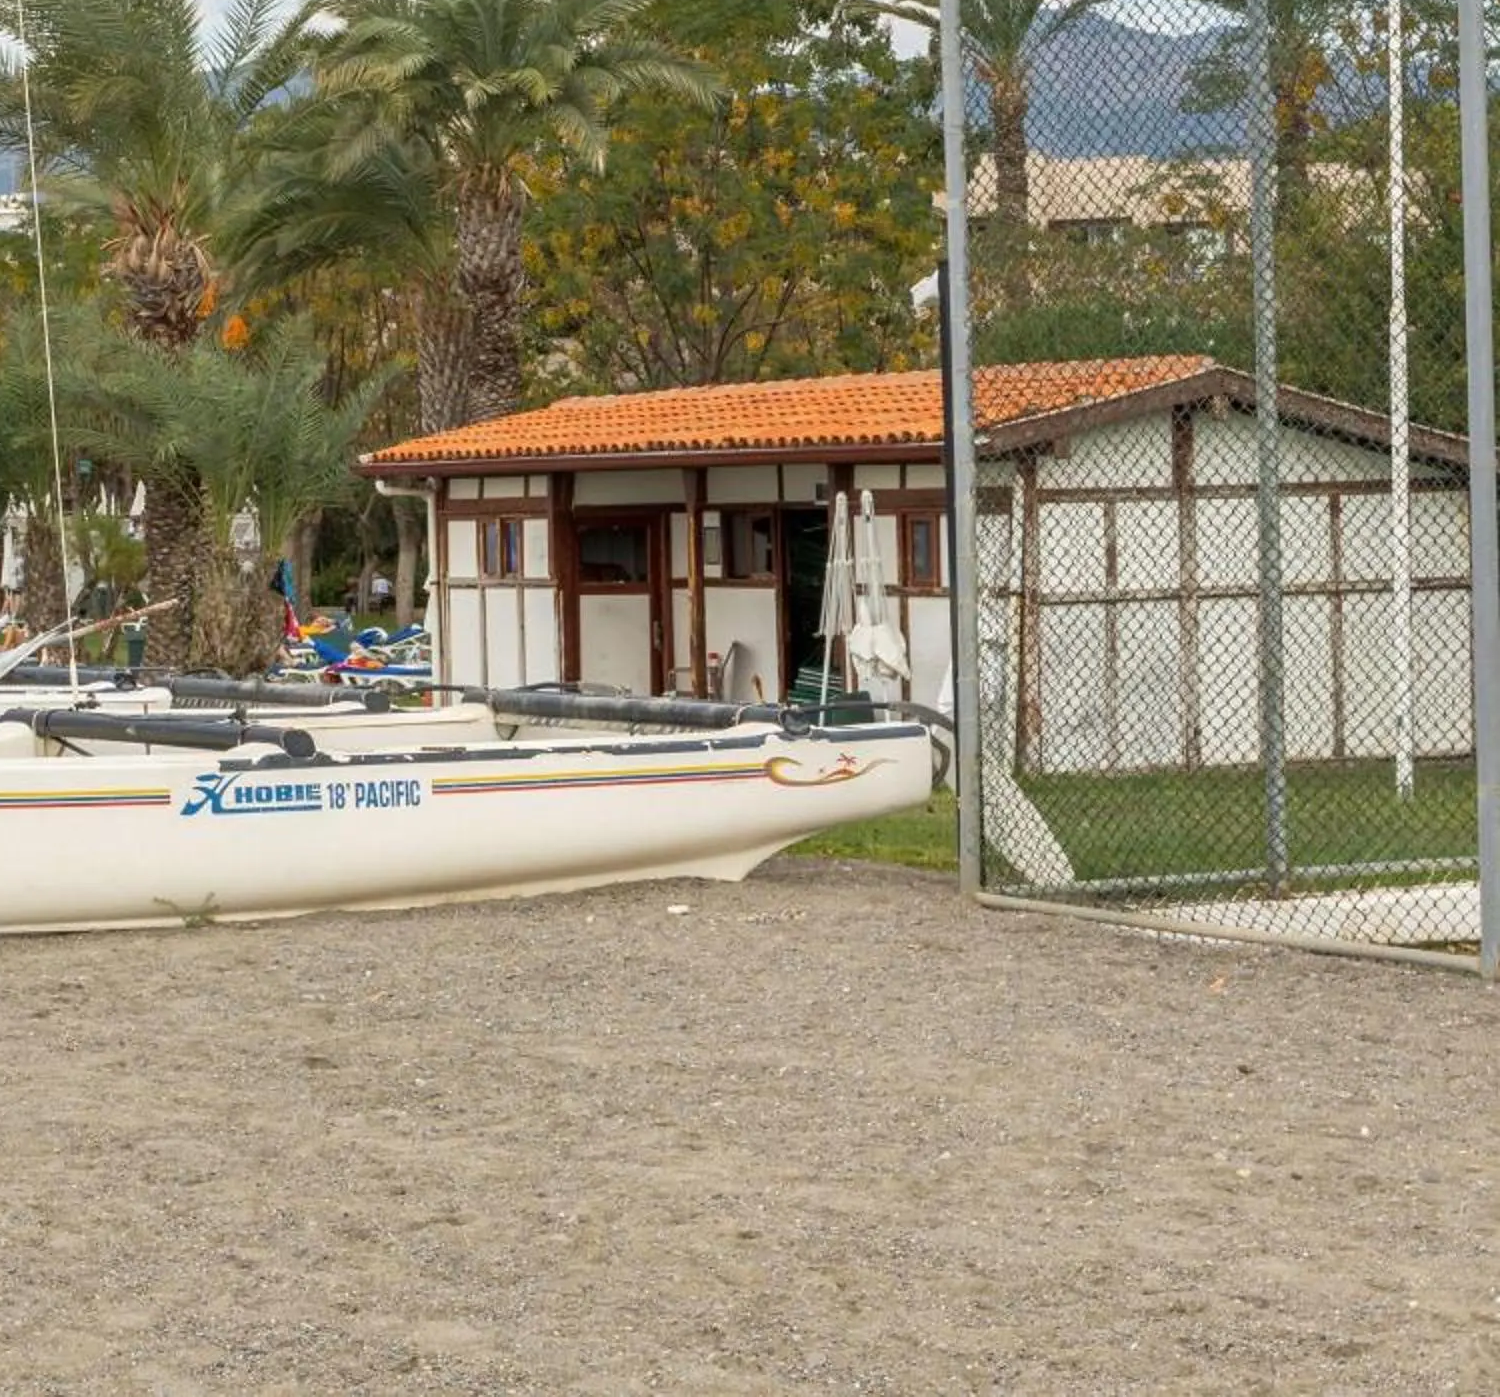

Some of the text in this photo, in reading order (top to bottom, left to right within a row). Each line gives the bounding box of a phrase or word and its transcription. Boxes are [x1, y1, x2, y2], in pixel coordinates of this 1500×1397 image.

[234, 780, 421, 809] HOBIE 18' PACIFIC
